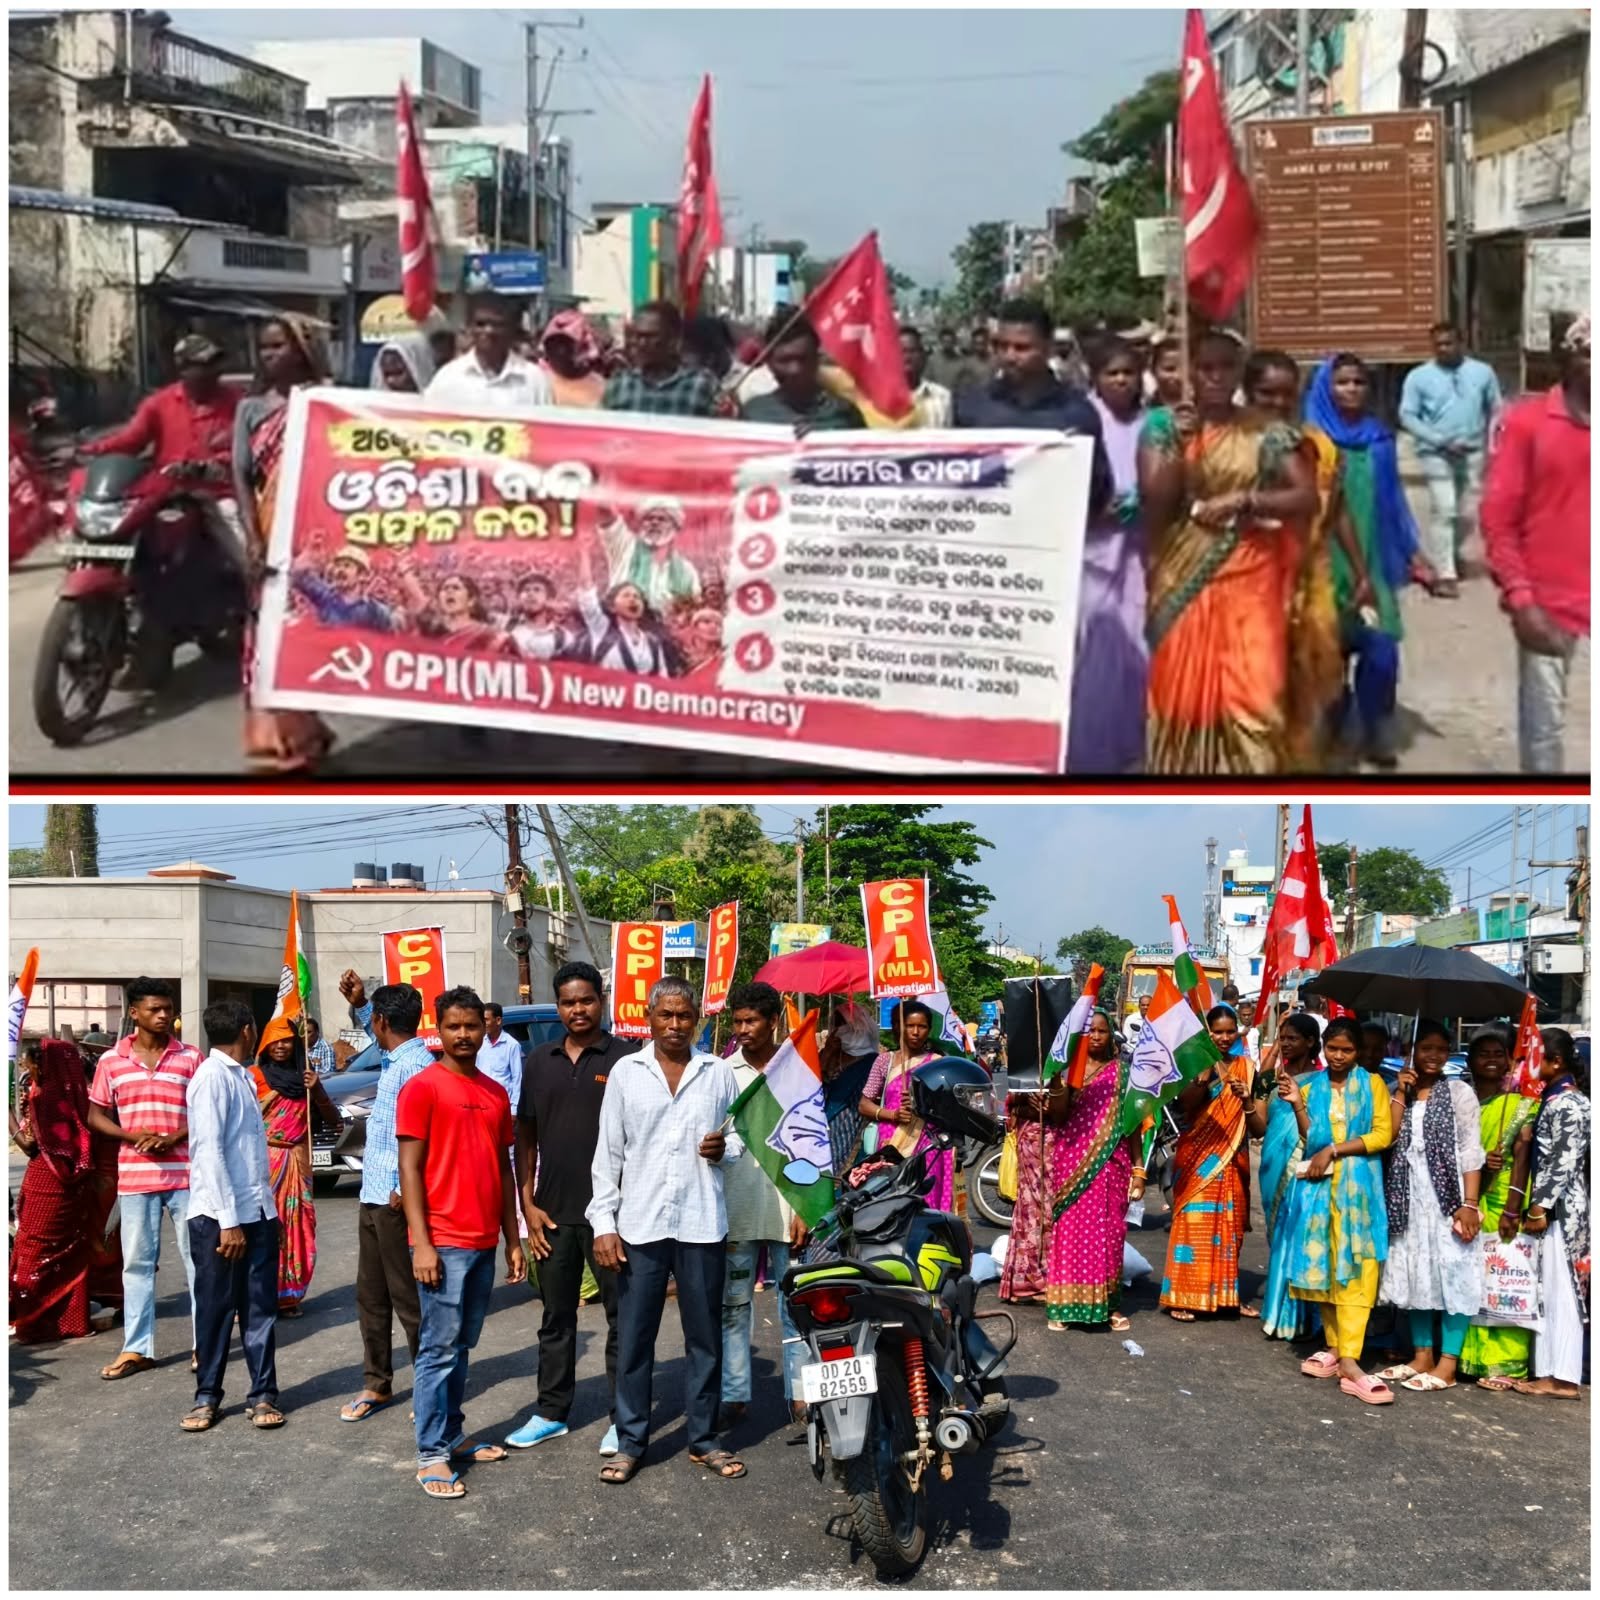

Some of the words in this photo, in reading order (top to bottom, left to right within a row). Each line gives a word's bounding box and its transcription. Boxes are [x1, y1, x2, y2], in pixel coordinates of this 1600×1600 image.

[747, 539, 766, 564] 2
[746, 586, 766, 611] 3
[743, 640, 764, 667] 4
[384, 649, 554, 710] CPI(ML)
[561, 674, 627, 710] New
[633, 682, 806, 738] Democracy
[879, 882, 915, 959] CPI
[665, 936, 692, 946] POLICE
[627, 929, 656, 1001] CPI
[878, 959, 931, 983] (ML)
[877, 982, 932, 997] Liberation
[618, 1022, 652, 1035] Liberat
[1489, 1264, 1531, 1278] Sunrise
[843, 1359, 861, 1375] 20
[820, 1375, 868, 1398] 82559
